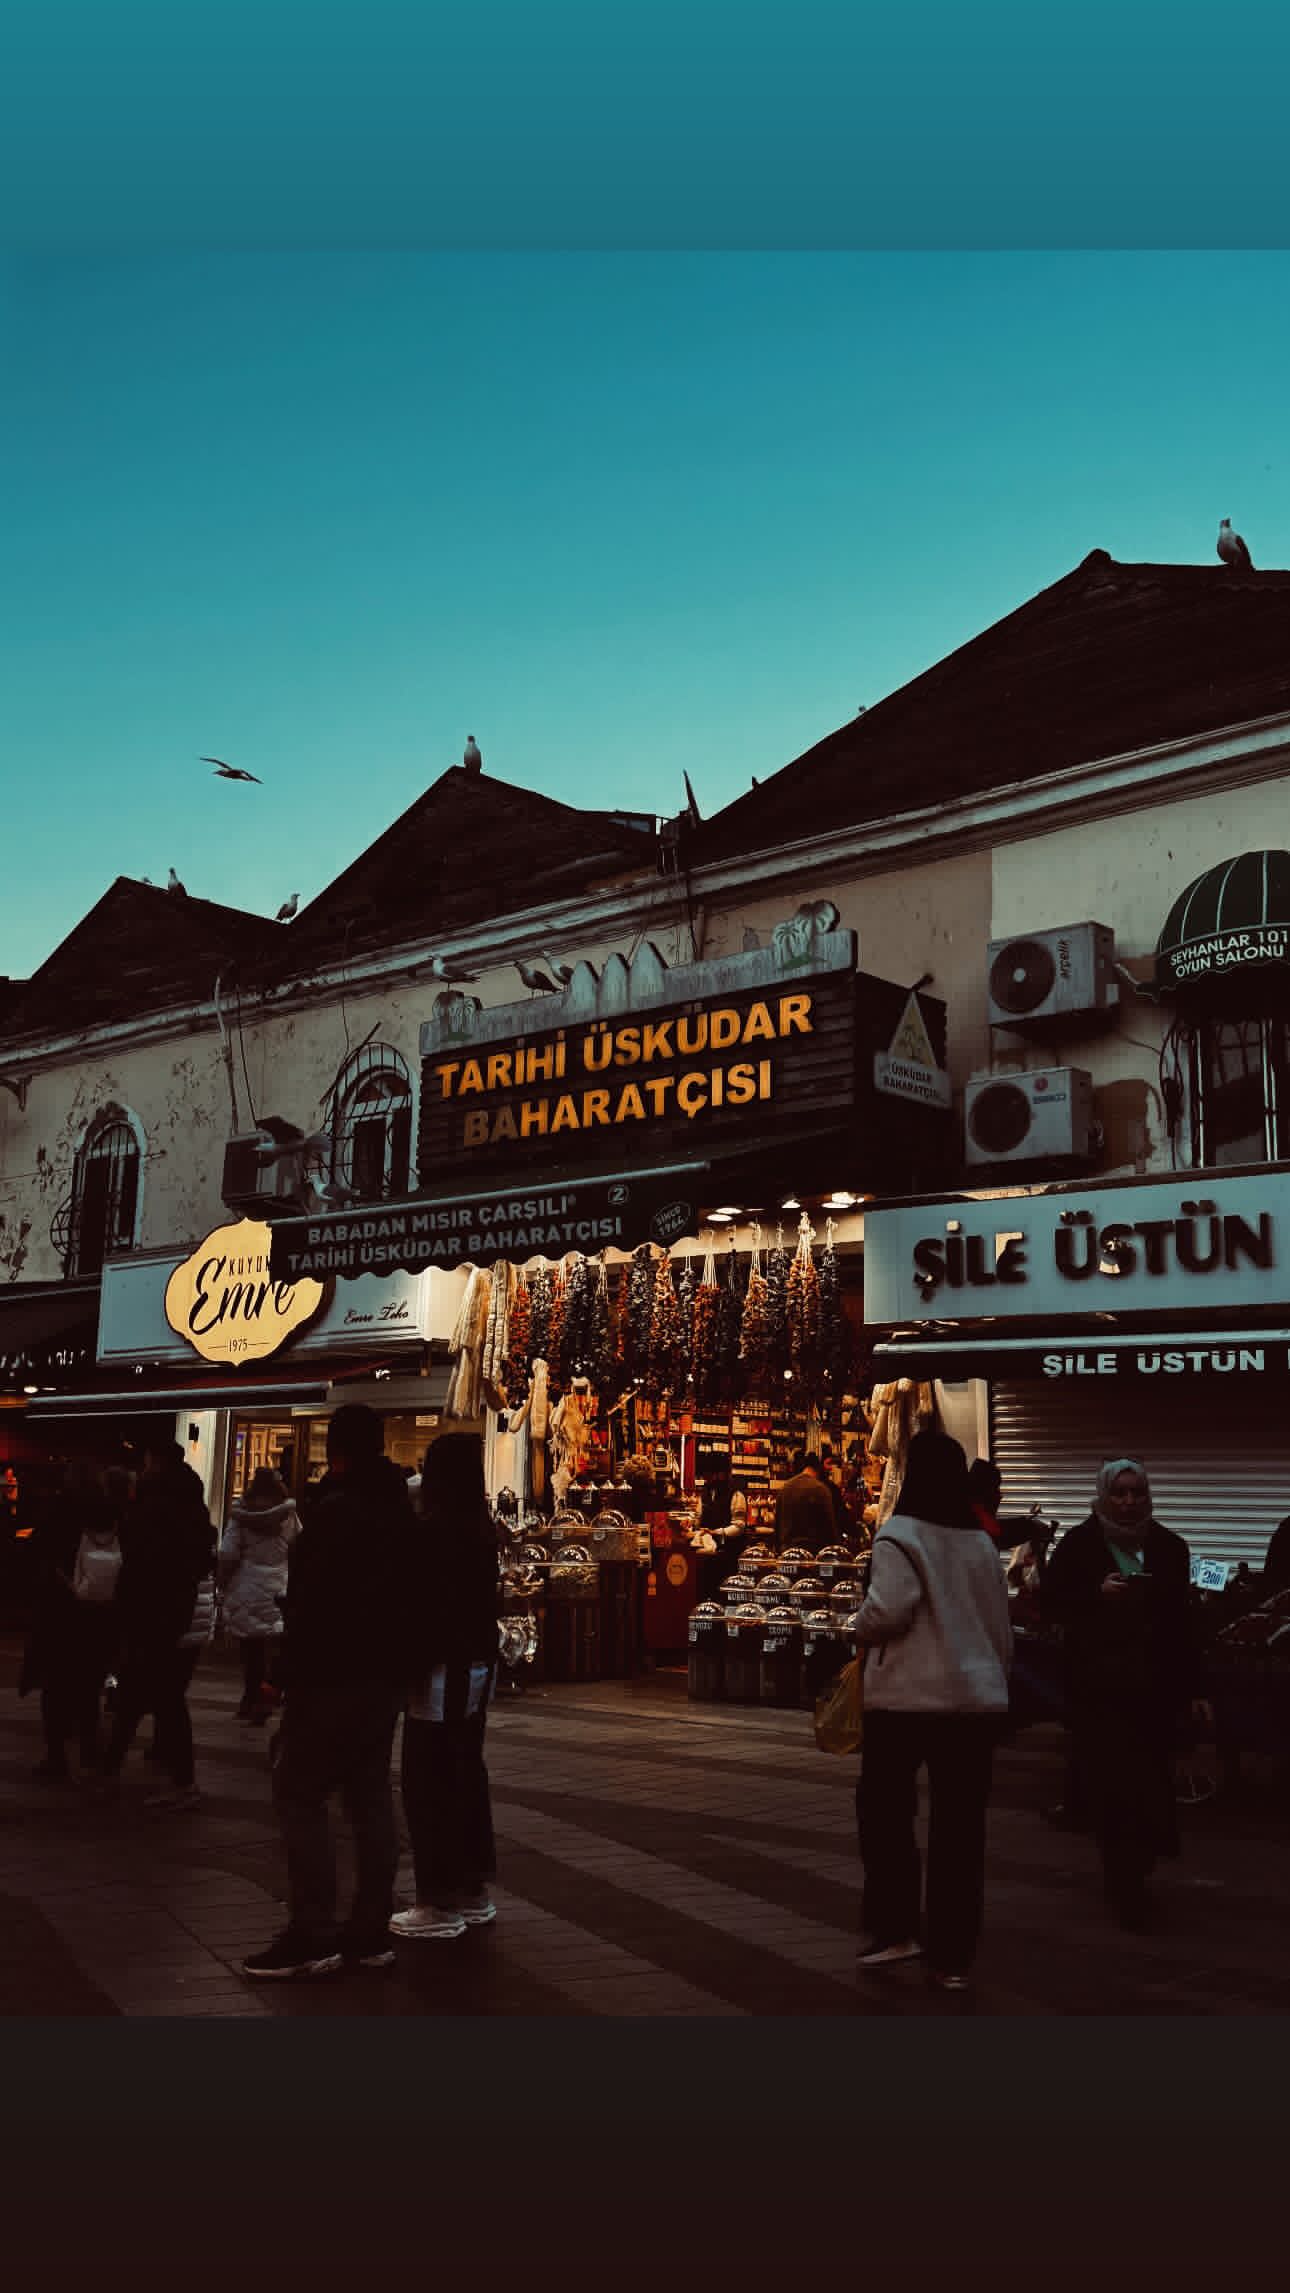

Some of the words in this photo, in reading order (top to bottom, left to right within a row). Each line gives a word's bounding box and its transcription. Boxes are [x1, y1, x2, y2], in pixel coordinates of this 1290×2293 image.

[1170, 934, 1250, 967] SEYHANLAR
[1257, 929, 1288, 944] 101
[1176, 955, 1211, 978] OYUN
[1216, 943, 1284, 967] SALONU
[435, 1029, 568, 1098] TARİHİ
[583, 993, 814, 1073] ÜSKÜDAR
[463, 1058, 774, 1147] BAHARATÇISI
[612, 1185, 625, 1202] 2
[288, 1244, 355, 1272] TARİHİ
[360, 1235, 460, 1263] ÜSKÜDAR
[468, 1215, 622, 1252] BAHARATÇISI
[308, 1217, 405, 1245] BABADAN
[913, 1219, 1028, 1300] ŞİLE
[1054, 1200, 1274, 1281] ÜSTÜN
[189, 1255, 295, 1335] Emre
[229, 1338, 248, 1353] 1975
[1042, 1352, 1119, 1378] ŞİLE
[1136, 1348, 1265, 1374] ÜSTÜN
